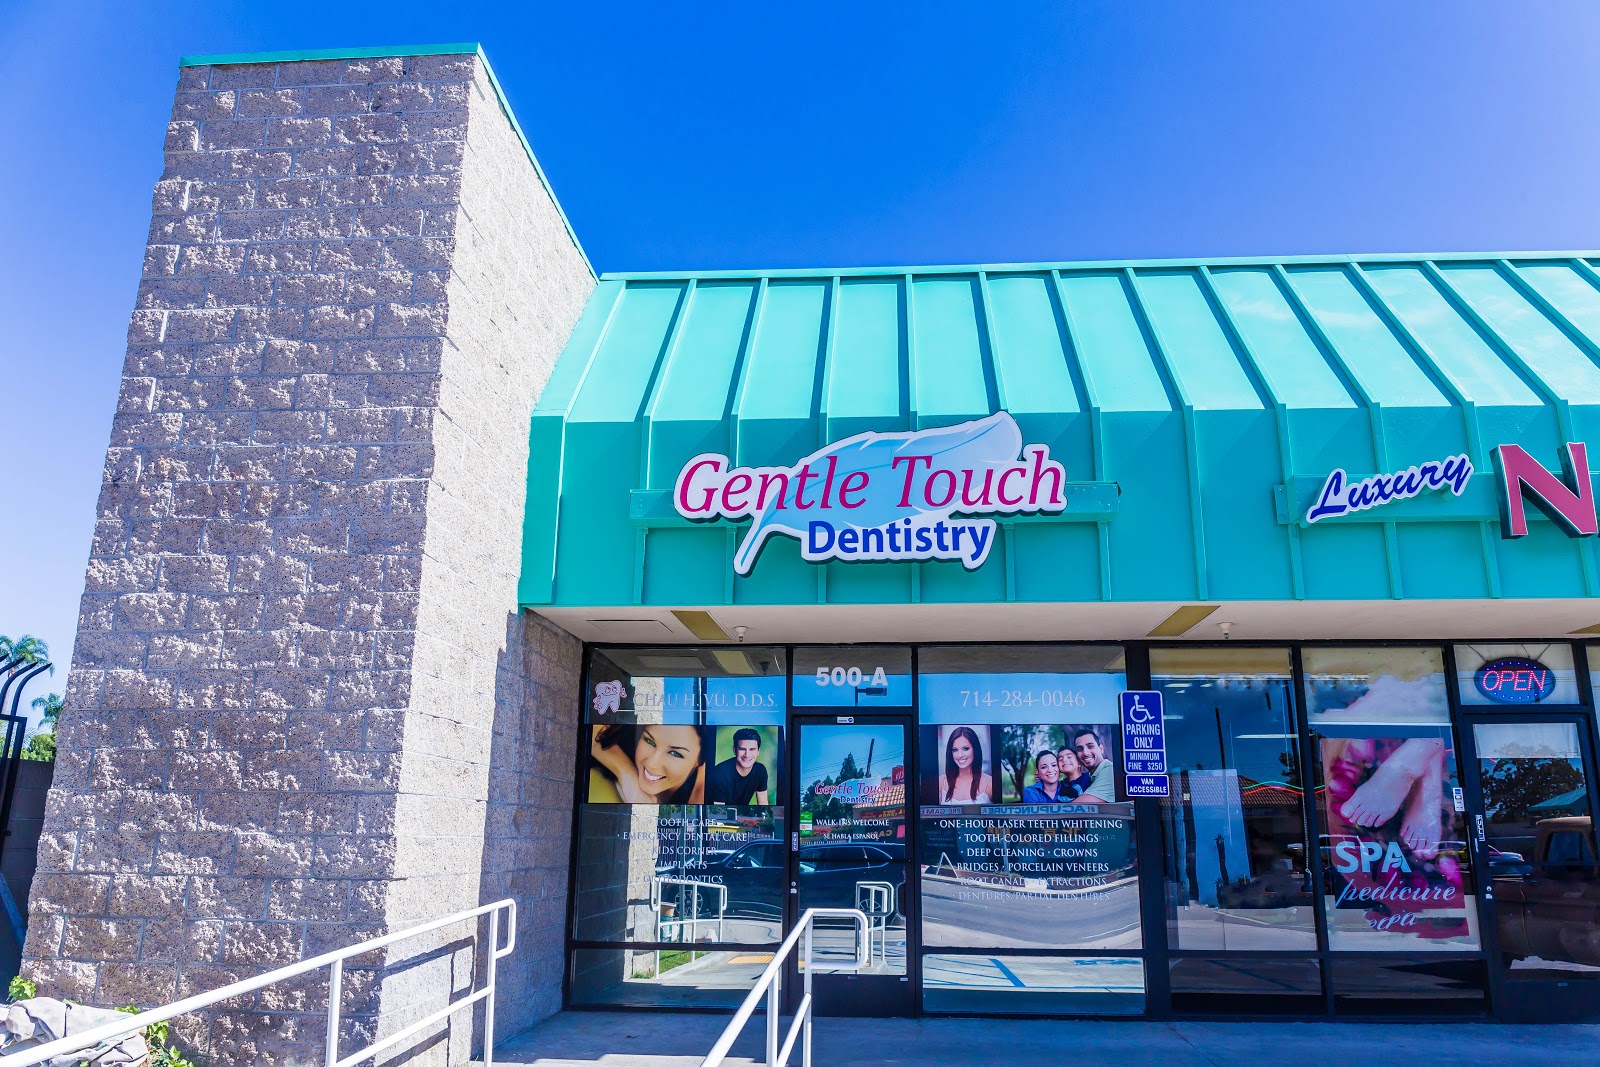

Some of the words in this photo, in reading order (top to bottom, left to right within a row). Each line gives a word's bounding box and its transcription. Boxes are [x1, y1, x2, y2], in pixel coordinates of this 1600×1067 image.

[679, 455, 870, 513] Gentle
[891, 450, 1062, 508] Touch
[1309, 457, 1472, 520] Luxury
[808, 518, 991, 561] Dentistry
[815, 666, 889, 687] 500-A
[1481, 669, 1547, 692] OPEN
[633, 693, 678, 707] CHAU
[734, 693, 778, 707] D.D.S.
[960, 690, 1086, 708] 714-284-0046
[1126, 723, 1161, 736] PARKING
[1133, 736, 1154, 749] ONLY
[1129, 752, 1160, 761] MINIMUM
[1128, 762, 1142, 771] FINE
[1147, 762, 1163, 771] $250
[1140, 777, 1154, 785] VAN
[814, 781, 853, 795] Gentle
[856, 781, 891, 795] Touch
[1129, 785, 1167, 794] ACCESSIBLE
[840, 795, 876, 804] Dentistry
[656, 818, 689, 827] TOOTH
[852, 818, 890, 826] WELCOME
[939, 819, 996, 829] ONE-HOUR
[997, 819, 1027, 829] LASER
[1029, 819, 1060, 829] TEETH
[1062, 819, 1123, 829] WHITENING
[623, 832, 682, 842] EMERGENCY
[683, 832, 720, 842] DENTAL
[723, 832, 747, 842] CARE
[964, 833, 1052, 843] TOOTH-COLORED
[1054, 833, 1100, 843] FILLINGS
[652, 846, 675, 855] KIDS
[676, 846, 717, 855] CORNER
[967, 847, 991, 858] DEEP
[993, 847, 1045, 858] CLEANING
[1053, 847, 1098, 858] CROWNS
[1334, 841, 1412, 874] SPA
[660, 860, 708, 870] IMPLANTS
[957, 862, 999, 872] BRIDGES
[1008, 862, 1064, 872] PORCELAIN
[1065, 862, 1110, 872] VENEERS
[643, 875, 723, 884] ORTHODONTICS
[960, 877, 989, 887] ROOT
[1038, 877, 1107, 887] EXTRACTIONS
[1335, 872, 1457, 909] pedicure
